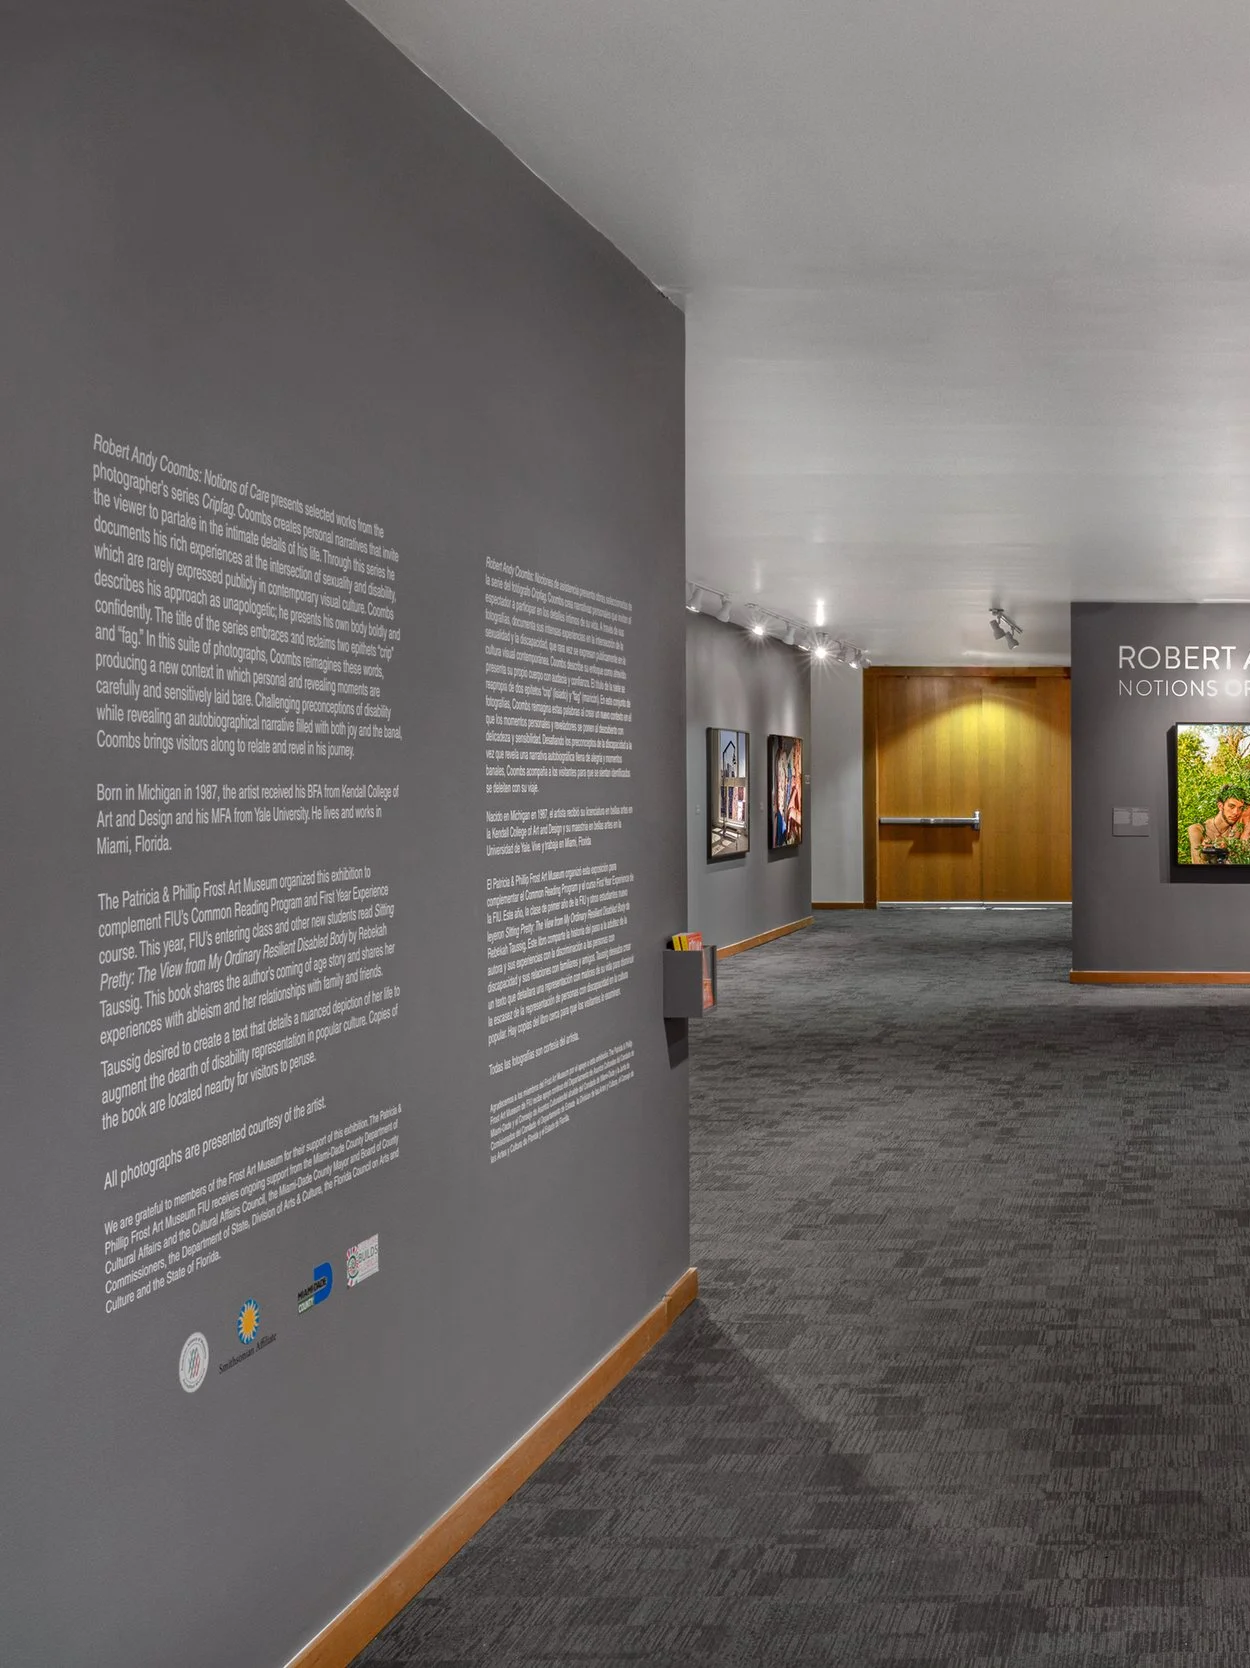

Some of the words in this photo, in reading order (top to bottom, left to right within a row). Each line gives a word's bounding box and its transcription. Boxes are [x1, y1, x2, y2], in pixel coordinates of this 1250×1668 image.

[94, 434, 130, 460] Robert
[132, 447, 157, 472] Andy
[160, 455, 201, 482] Coombs:
[204, 469, 237, 493] Notions
[239, 482, 248, 496] of
[250, 484, 269, 503] Care
[271, 494, 303, 514] presents
[305, 504, 334, 523] selected
[336, 515, 356, 530] works
[358, 518, 372, 534] from
[374, 524, 384, 538] the
[94, 488, 110, 507] the
[114, 494, 146, 516] viewer
[149, 504, 158, 520] to
[162, 510, 196, 530] partake
[199, 516, 207, 532] in
[210, 520, 223, 536] the
[226, 523, 259, 546] intimate
[261, 534, 286, 552] details
[288, 541, 295, 555] of
[297, 543, 308, 558] his
[310, 546, 321, 562] life.
[324, 549, 351, 572] Through
[353, 559, 365, 573] this
[367, 564, 385, 578] series
[387, 567, 395, 581] he
[94, 515, 150, 543] documents
[154, 529, 167, 547] his
[171, 534, 187, 552] rich
[190, 542, 242, 565] experiences
[245, 554, 253, 567] at
[255, 555, 268, 571] the
[270, 558, 312, 581] intersection
[314, 570, 321, 583] of
[323, 574, 352, 594] sexuality
[354, 581, 366, 594] and
[171, 487, 199, 506] series
[203, 493, 235, 519] Cripfag.
[238, 503, 271, 526] Coombs
[273, 517, 301, 535] creates
[303, 526, 333, 544] personal
[335, 535, 367, 553] narratives
[369, 543, 381, 557] that
[383, 546, 399, 562] invite
[94, 543, 124, 563] which
[127, 553, 144, 568] are
[147, 557, 174, 578] rarely
[177, 564, 223, 584] expressed
[225, 573, 257, 595] publicly
[259, 578, 266, 593] in
[268, 584, 318, 607] contemporary
[321, 592, 340, 608] visual
[342, 598, 366, 614] culture.
[368, 602, 394, 620] Coombs
[94, 569, 144, 594] describes
[147, 579, 161, 597] his
[164, 586, 207, 605] approach
[210, 595, 220, 608] as
[223, 597, 277, 620] unapologetic;
[279, 604, 288, 620] he
[291, 611, 321, 626] presents
[323, 613, 334, 628] his
[335, 619, 349, 631] own
[351, 619, 367, 638] body
[369, 623, 387, 641] boldly
[389, 629, 400, 641] and
[1119, 646, 1236, 670] ROBERT
[1119, 680, 1218, 697] NOTIONS
[97, 784, 122, 801] Born
[126, 784, 134, 800] in
[138, 784, 181, 804] Michigan
[184, 785, 192, 800] in
[196, 785, 220, 801] 1987,
[223, 785, 236, 799] the
[239, 785, 259, 799] artist
[262, 785, 293, 799] received
[295, 785, 306, 798] his
[308, 784, 322, 798] BFA
[324, 784, 340, 798] from
[342, 785, 366, 798] Kendall
[368, 784, 391, 800] College
[393, 785, 399, 797] of
[97, 811, 113, 827] Art
[116, 810, 135, 827] and
[139, 810, 173, 829] Design
[176, 809, 193, 825] and
[196, 809, 209, 824] his
[212, 808, 231, 823] MFA
[234, 808, 252, 822] from
[255, 807, 271, 822] Yale
[273, 807, 310, 824] University.
[312, 806, 322, 819] He
[324, 806, 339, 819] lives
[341, 806, 354, 819] and
[355, 805, 374, 818] works
[376, 805, 382, 817] in
[97, 836, 131, 855] Miami,
[136, 835, 172, 852] Florida.
[99, 893, 119, 910] The
[123, 888, 160, 908] Patricia
[163, 887, 169, 902] &
[173, 884, 201, 902] Phillip
[204, 881, 226, 897] Frost
[228, 880, 241, 894] Art
[244, 877, 277, 892] Museum
[280, 871, 315, 891] organized
[317, 870, 329, 883] this
[331, 867, 363, 882] exhibition
[364, 866, 371, 878] to
[104, 1170, 117, 1190] All
[121, 1150, 182, 1188] photographs
[185, 1144, 200, 1160] are
[203, 1124, 246, 1157] presented
[248, 1114, 282, 1136] courtesy
[284, 1107, 292, 1123] of
[294, 1105, 305, 1119] the
[307, 1096, 326, 1114] artist.
[106, 1292, 134, 1313] Culture
[137, 1281, 151, 1299] and
[153, 1278, 165, 1291] the
[167, 1268, 185, 1284] State
[187, 1260, 194, 1274] of
[196, 1251, 221, 1270] Florida.
